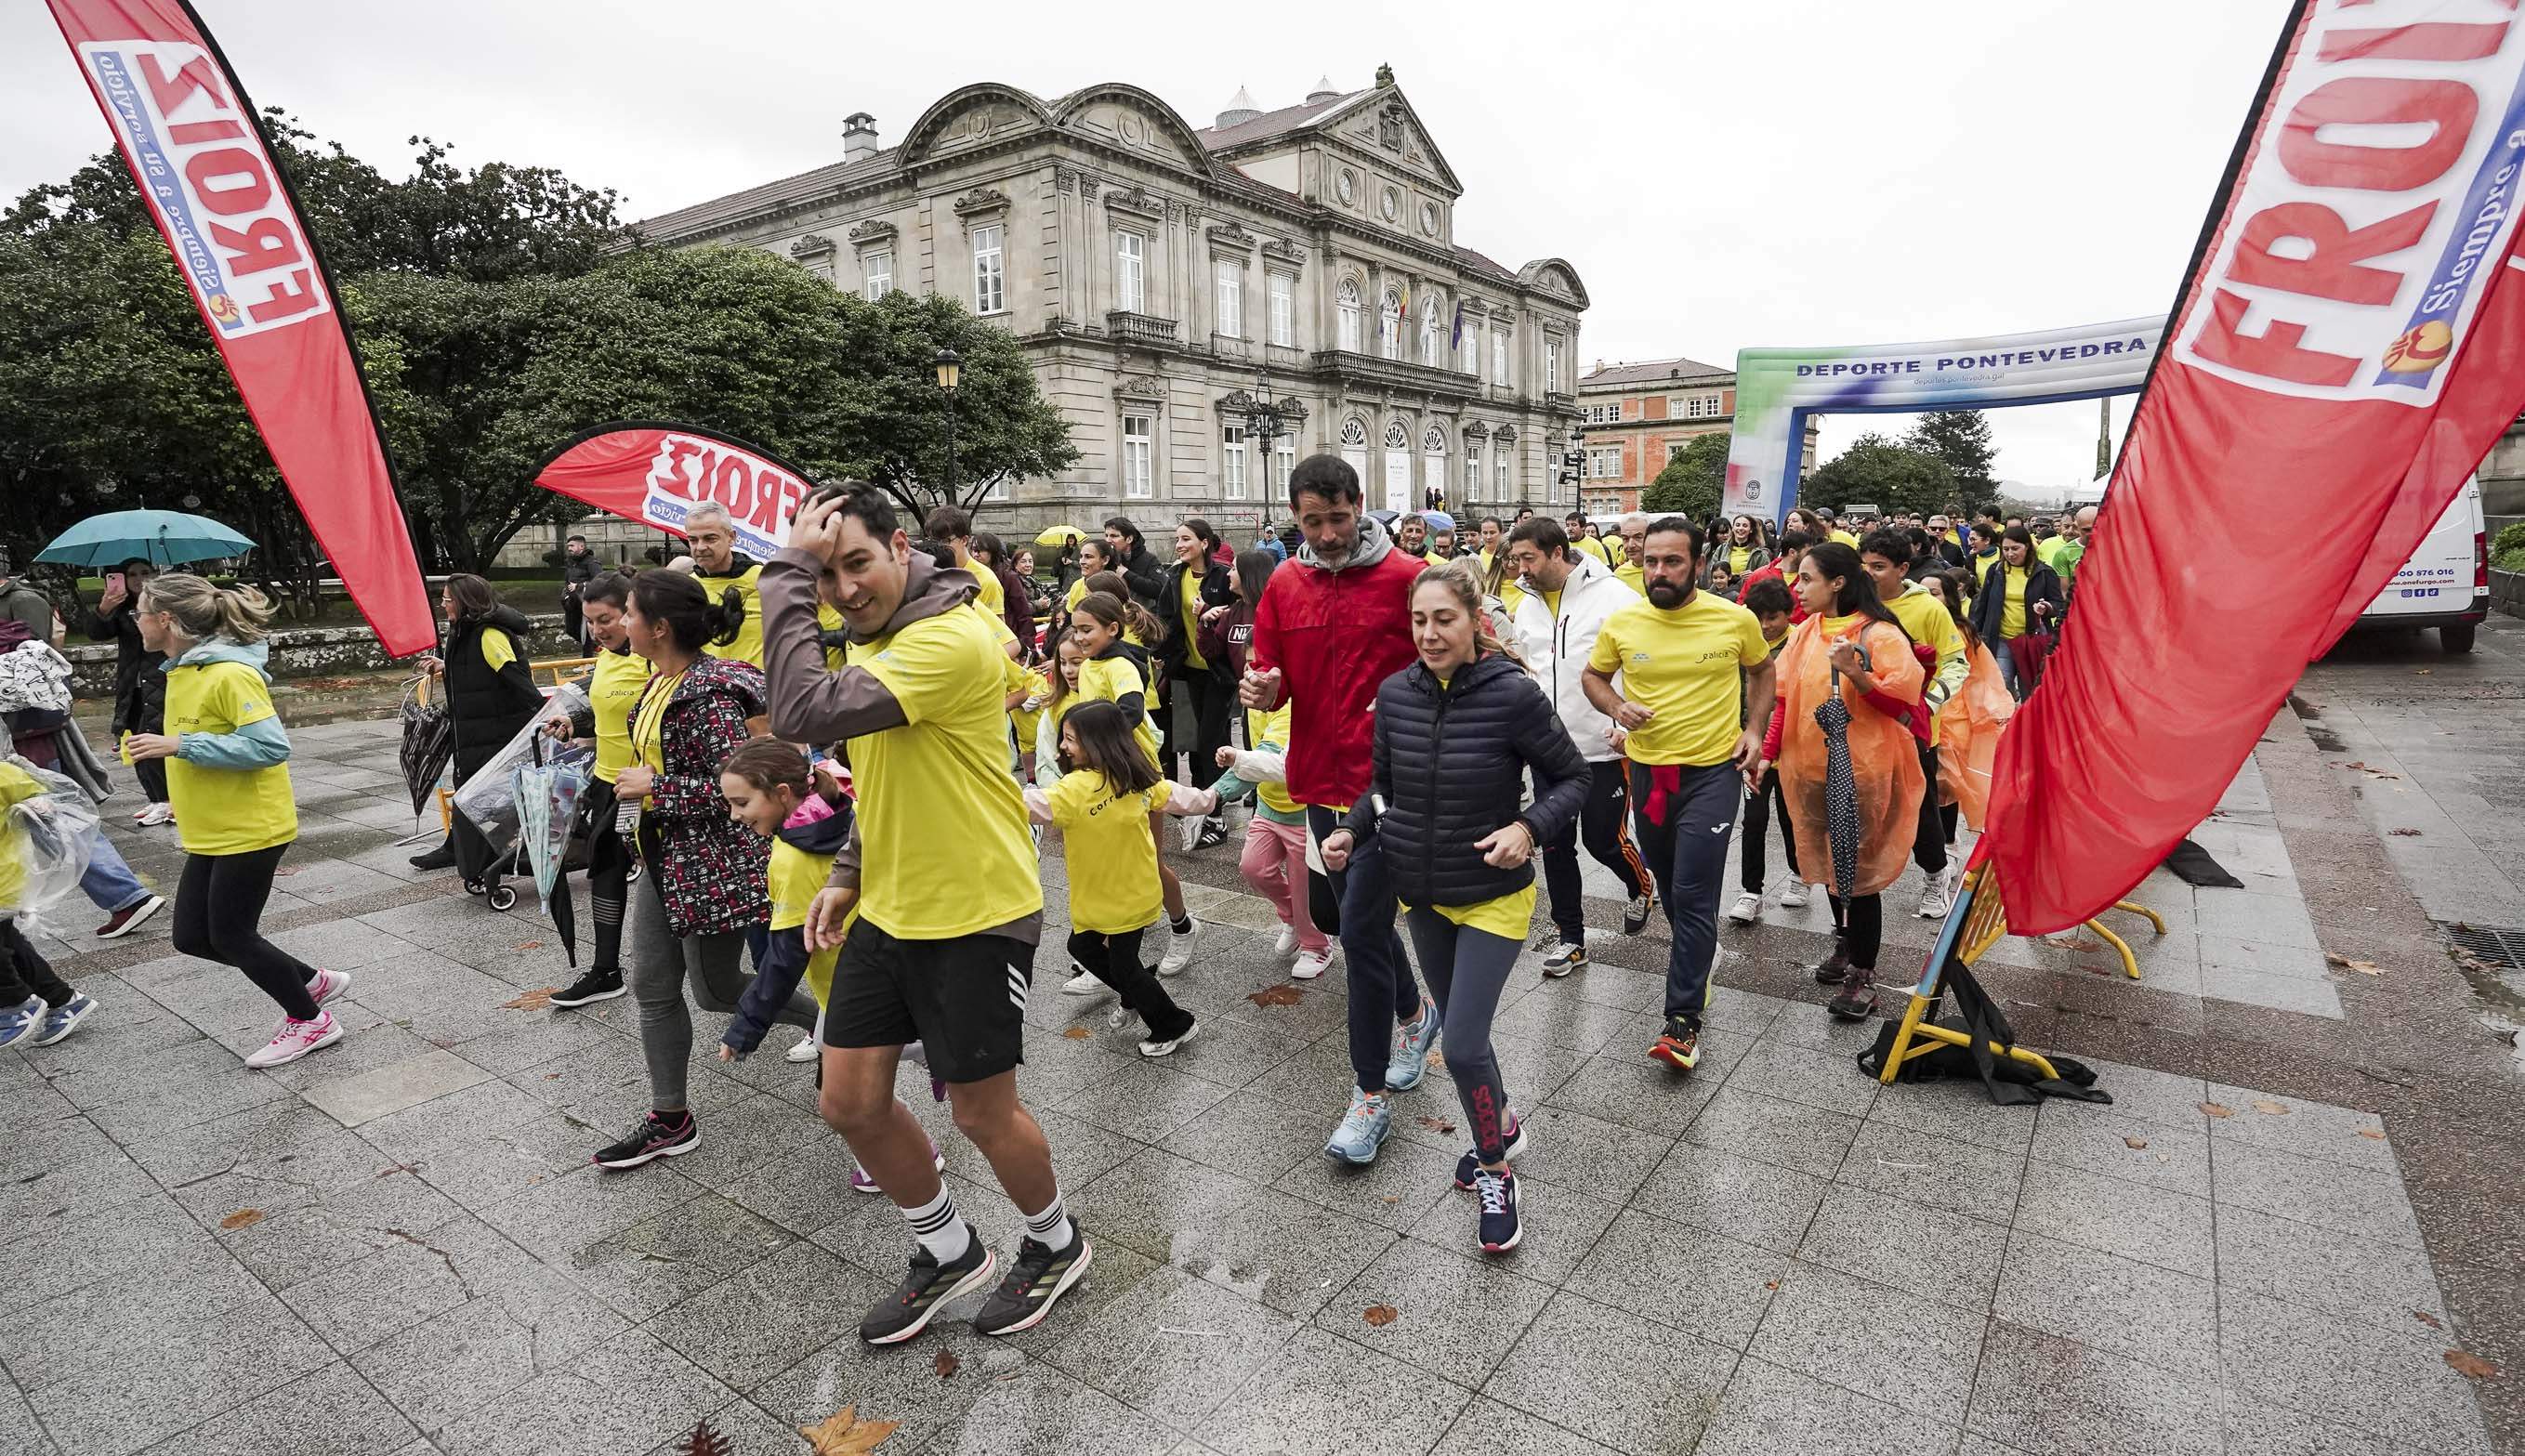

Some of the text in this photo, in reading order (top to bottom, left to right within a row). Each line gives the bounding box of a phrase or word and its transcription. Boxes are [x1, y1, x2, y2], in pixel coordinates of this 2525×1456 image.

[2190, 0, 2518, 387] FROI
[2423, 162, 2515, 314] Siempre
[1795, 337, 2147, 377] DEPORTE PONTEVEDRA
